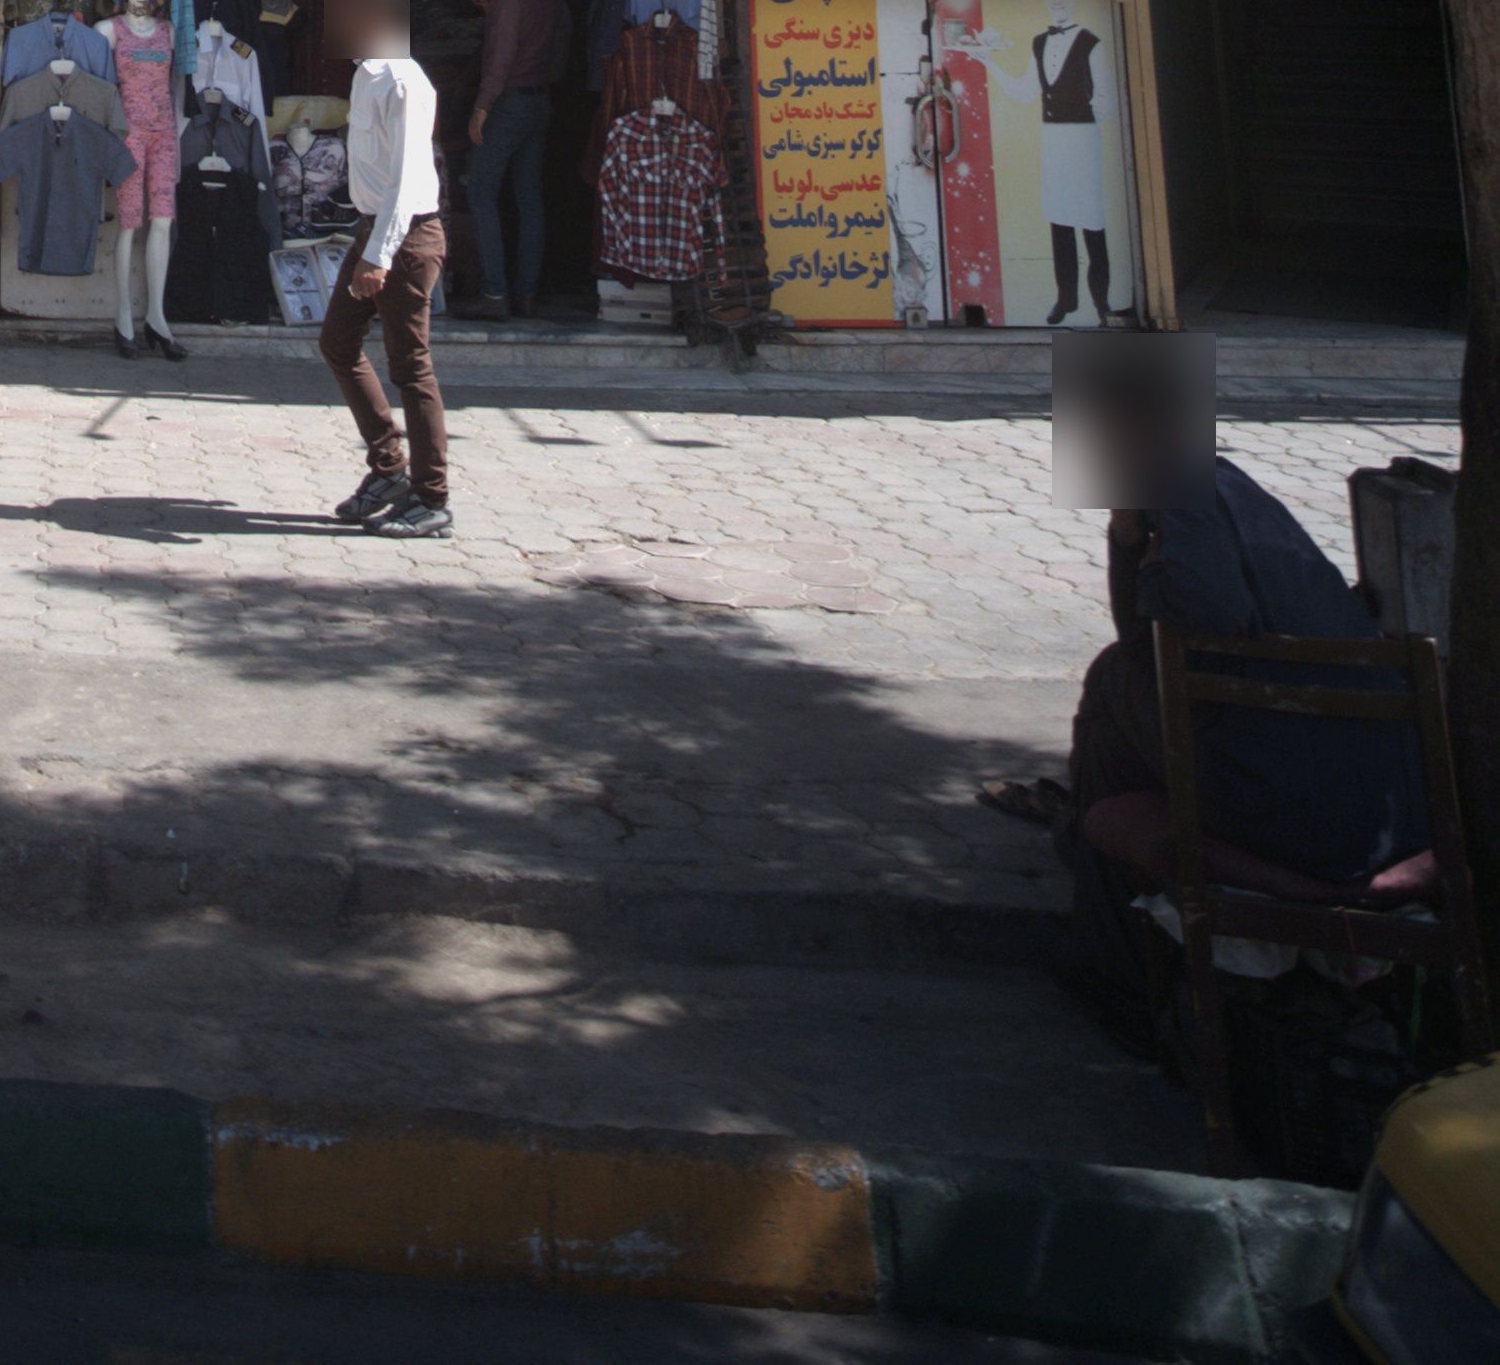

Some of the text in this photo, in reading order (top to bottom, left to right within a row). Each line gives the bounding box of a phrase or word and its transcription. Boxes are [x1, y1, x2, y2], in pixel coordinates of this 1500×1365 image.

[763, 15, 876, 50] دیزی سنگی
[757, 56, 876, 98] استامبولی
[834, 100, 878, 121] کشک
[767, 249, 869, 289] خانوادگی
